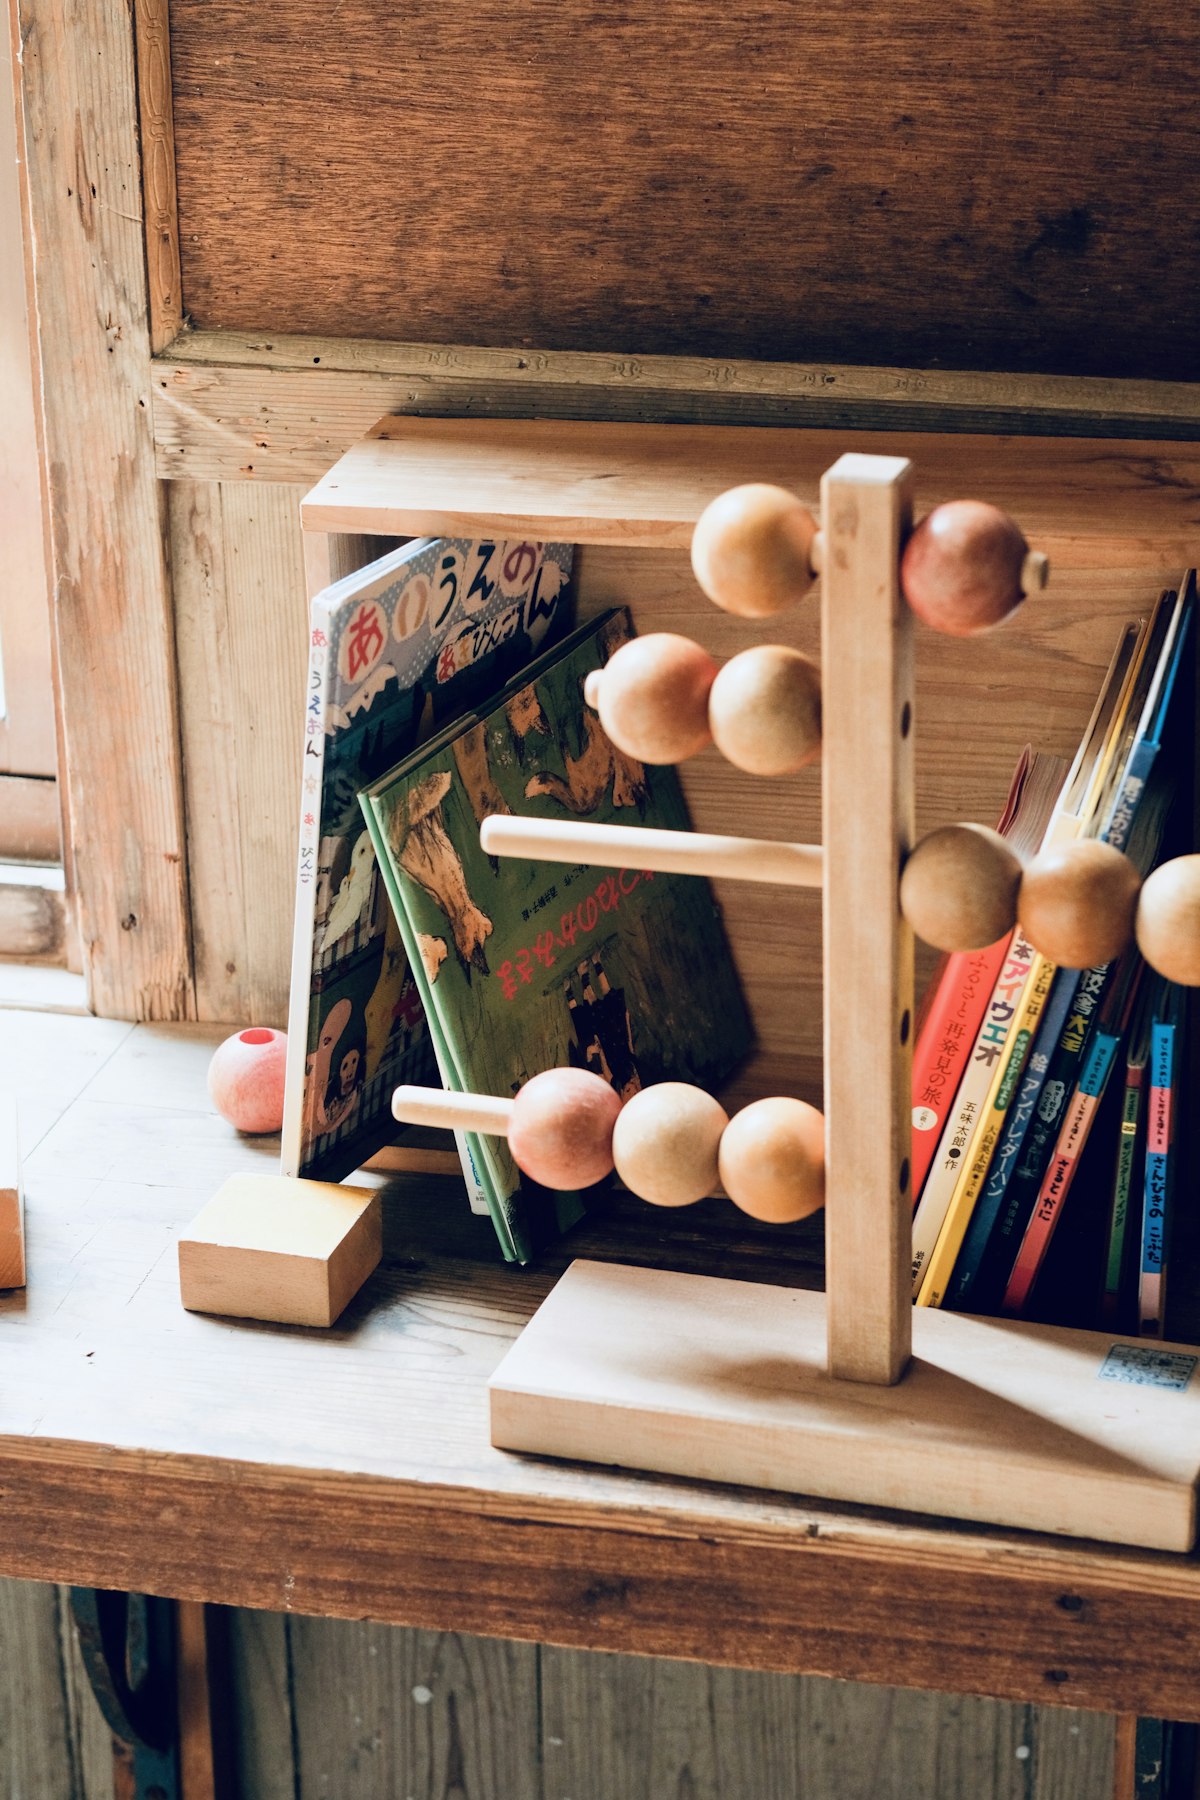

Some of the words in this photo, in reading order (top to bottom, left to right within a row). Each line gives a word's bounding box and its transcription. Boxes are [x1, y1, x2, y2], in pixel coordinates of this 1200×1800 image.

[304, 628, 328, 758] あいうえおん
[1029, 1051, 1049, 1074] 絵
